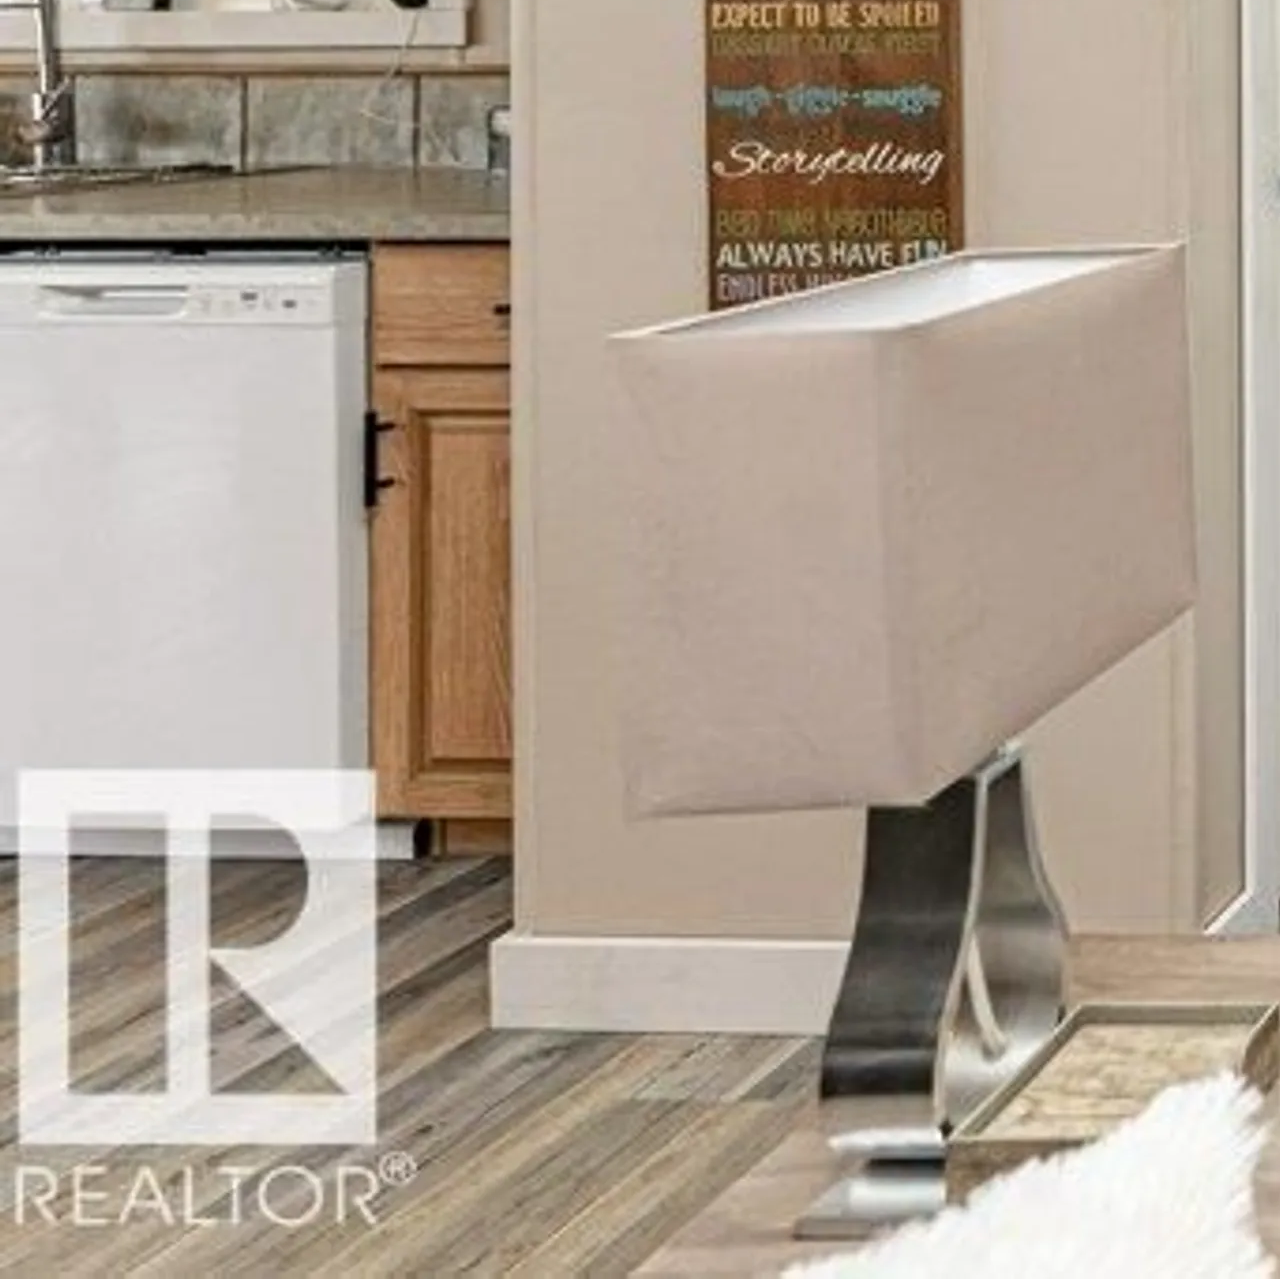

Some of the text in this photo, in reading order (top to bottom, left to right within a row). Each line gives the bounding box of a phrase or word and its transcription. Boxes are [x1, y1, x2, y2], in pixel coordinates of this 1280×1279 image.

[712, 2, 939, 28] EXPECT TO BE SPOILED
[712, 142, 944, 185] Storytelling
[716, 242, 823, 268] ALWAYS
[828, 242, 893, 268] HAVE
